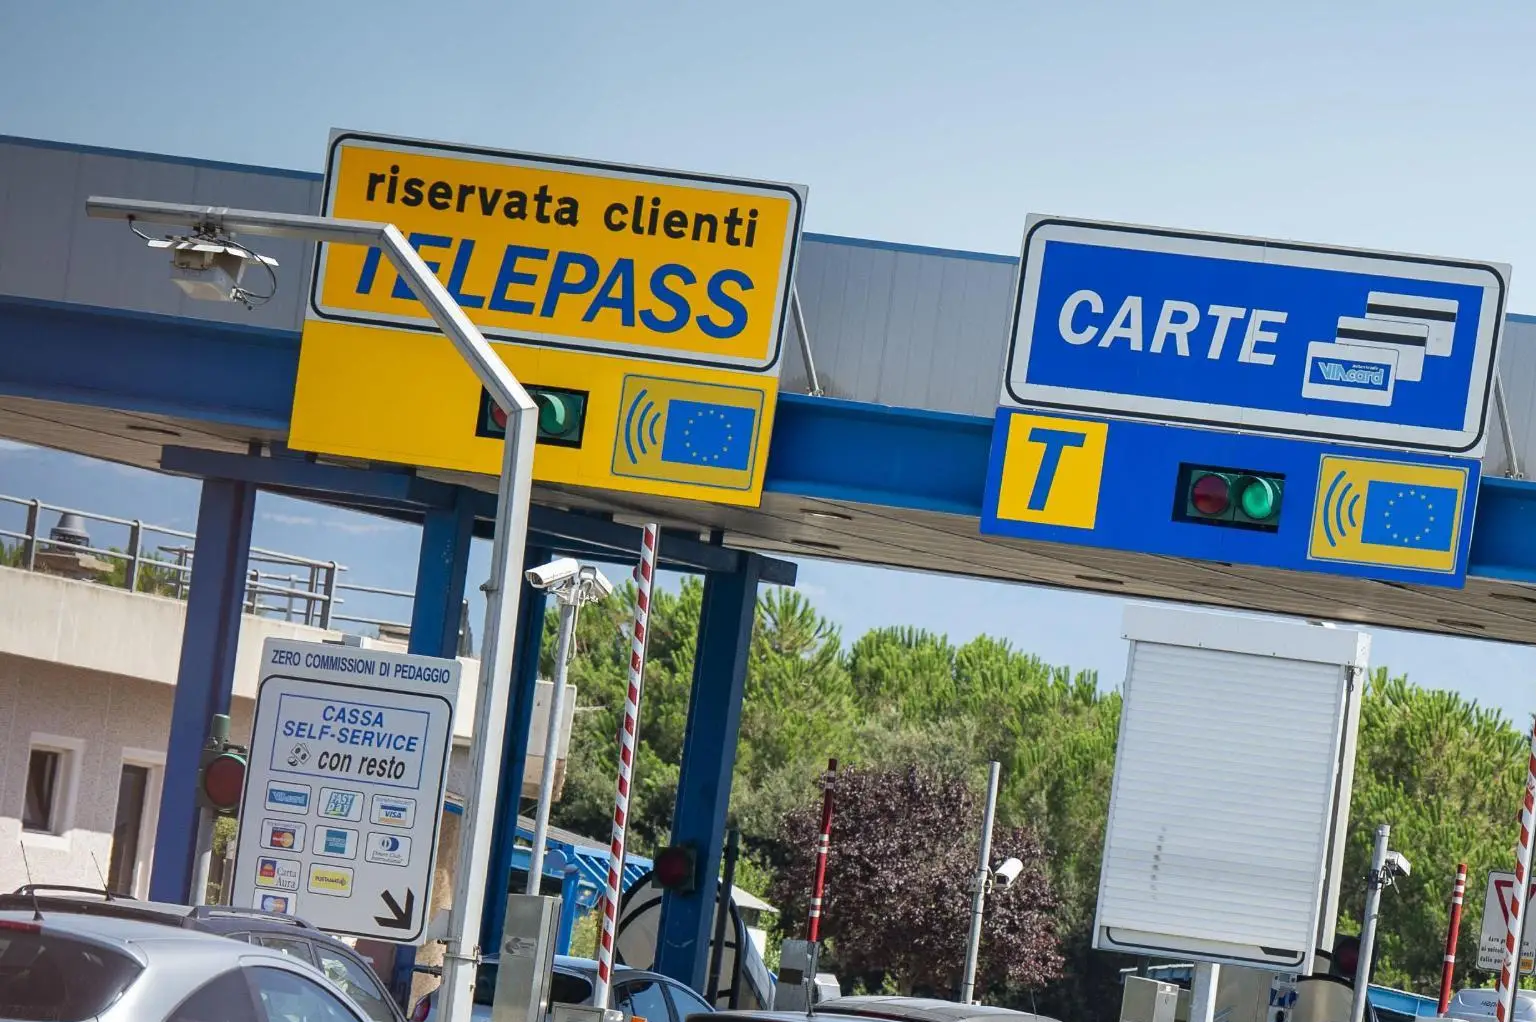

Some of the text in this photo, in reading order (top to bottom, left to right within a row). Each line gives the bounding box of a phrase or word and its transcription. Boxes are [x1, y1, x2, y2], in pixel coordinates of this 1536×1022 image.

[366, 164, 760, 248] riservata clienti
[1058, 289, 1289, 366] CARTE
[1027, 428, 1087, 512] T
[271, 650, 450, 684] ZERO COMMISSIONI DI PEDAGGIO
[322, 705, 384, 728] CASSA
[283, 720, 419, 752] SELF-SERVICE
[318, 751, 406, 780] con resto
[384, 810, 402, 818] VISA
